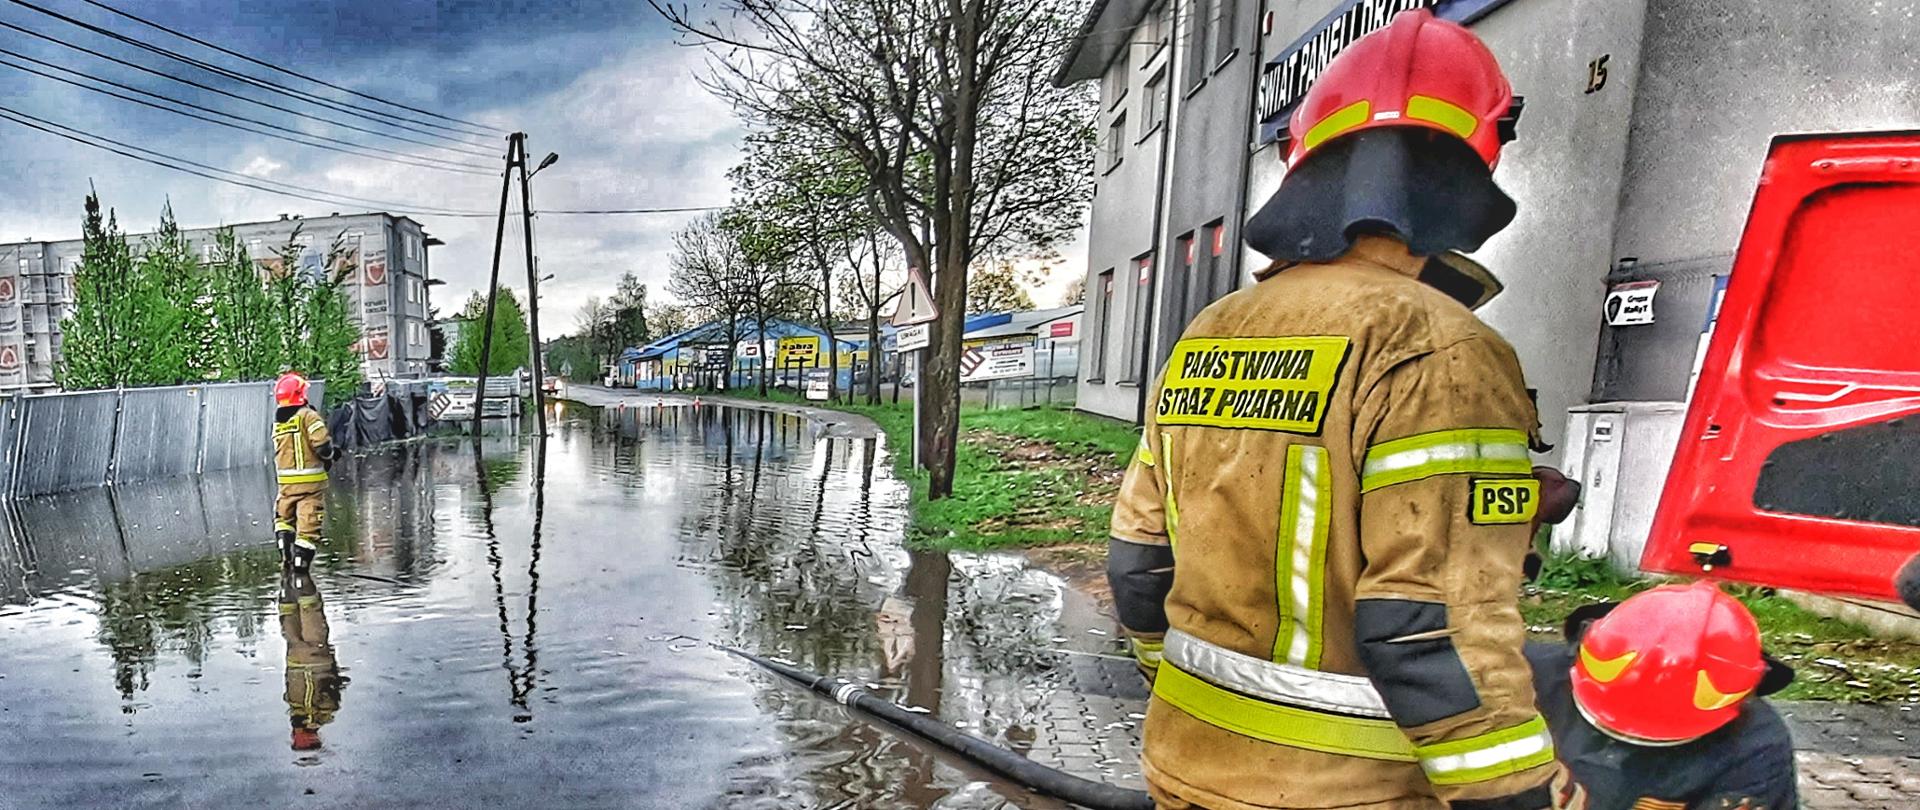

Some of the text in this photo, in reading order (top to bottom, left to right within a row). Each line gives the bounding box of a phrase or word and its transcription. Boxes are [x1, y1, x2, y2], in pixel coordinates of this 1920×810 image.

[1584, 54, 1610, 94] 15
[1181, 345, 1314, 380] PAŃSTWOWA
[1482, 486, 1530, 515] PSP
